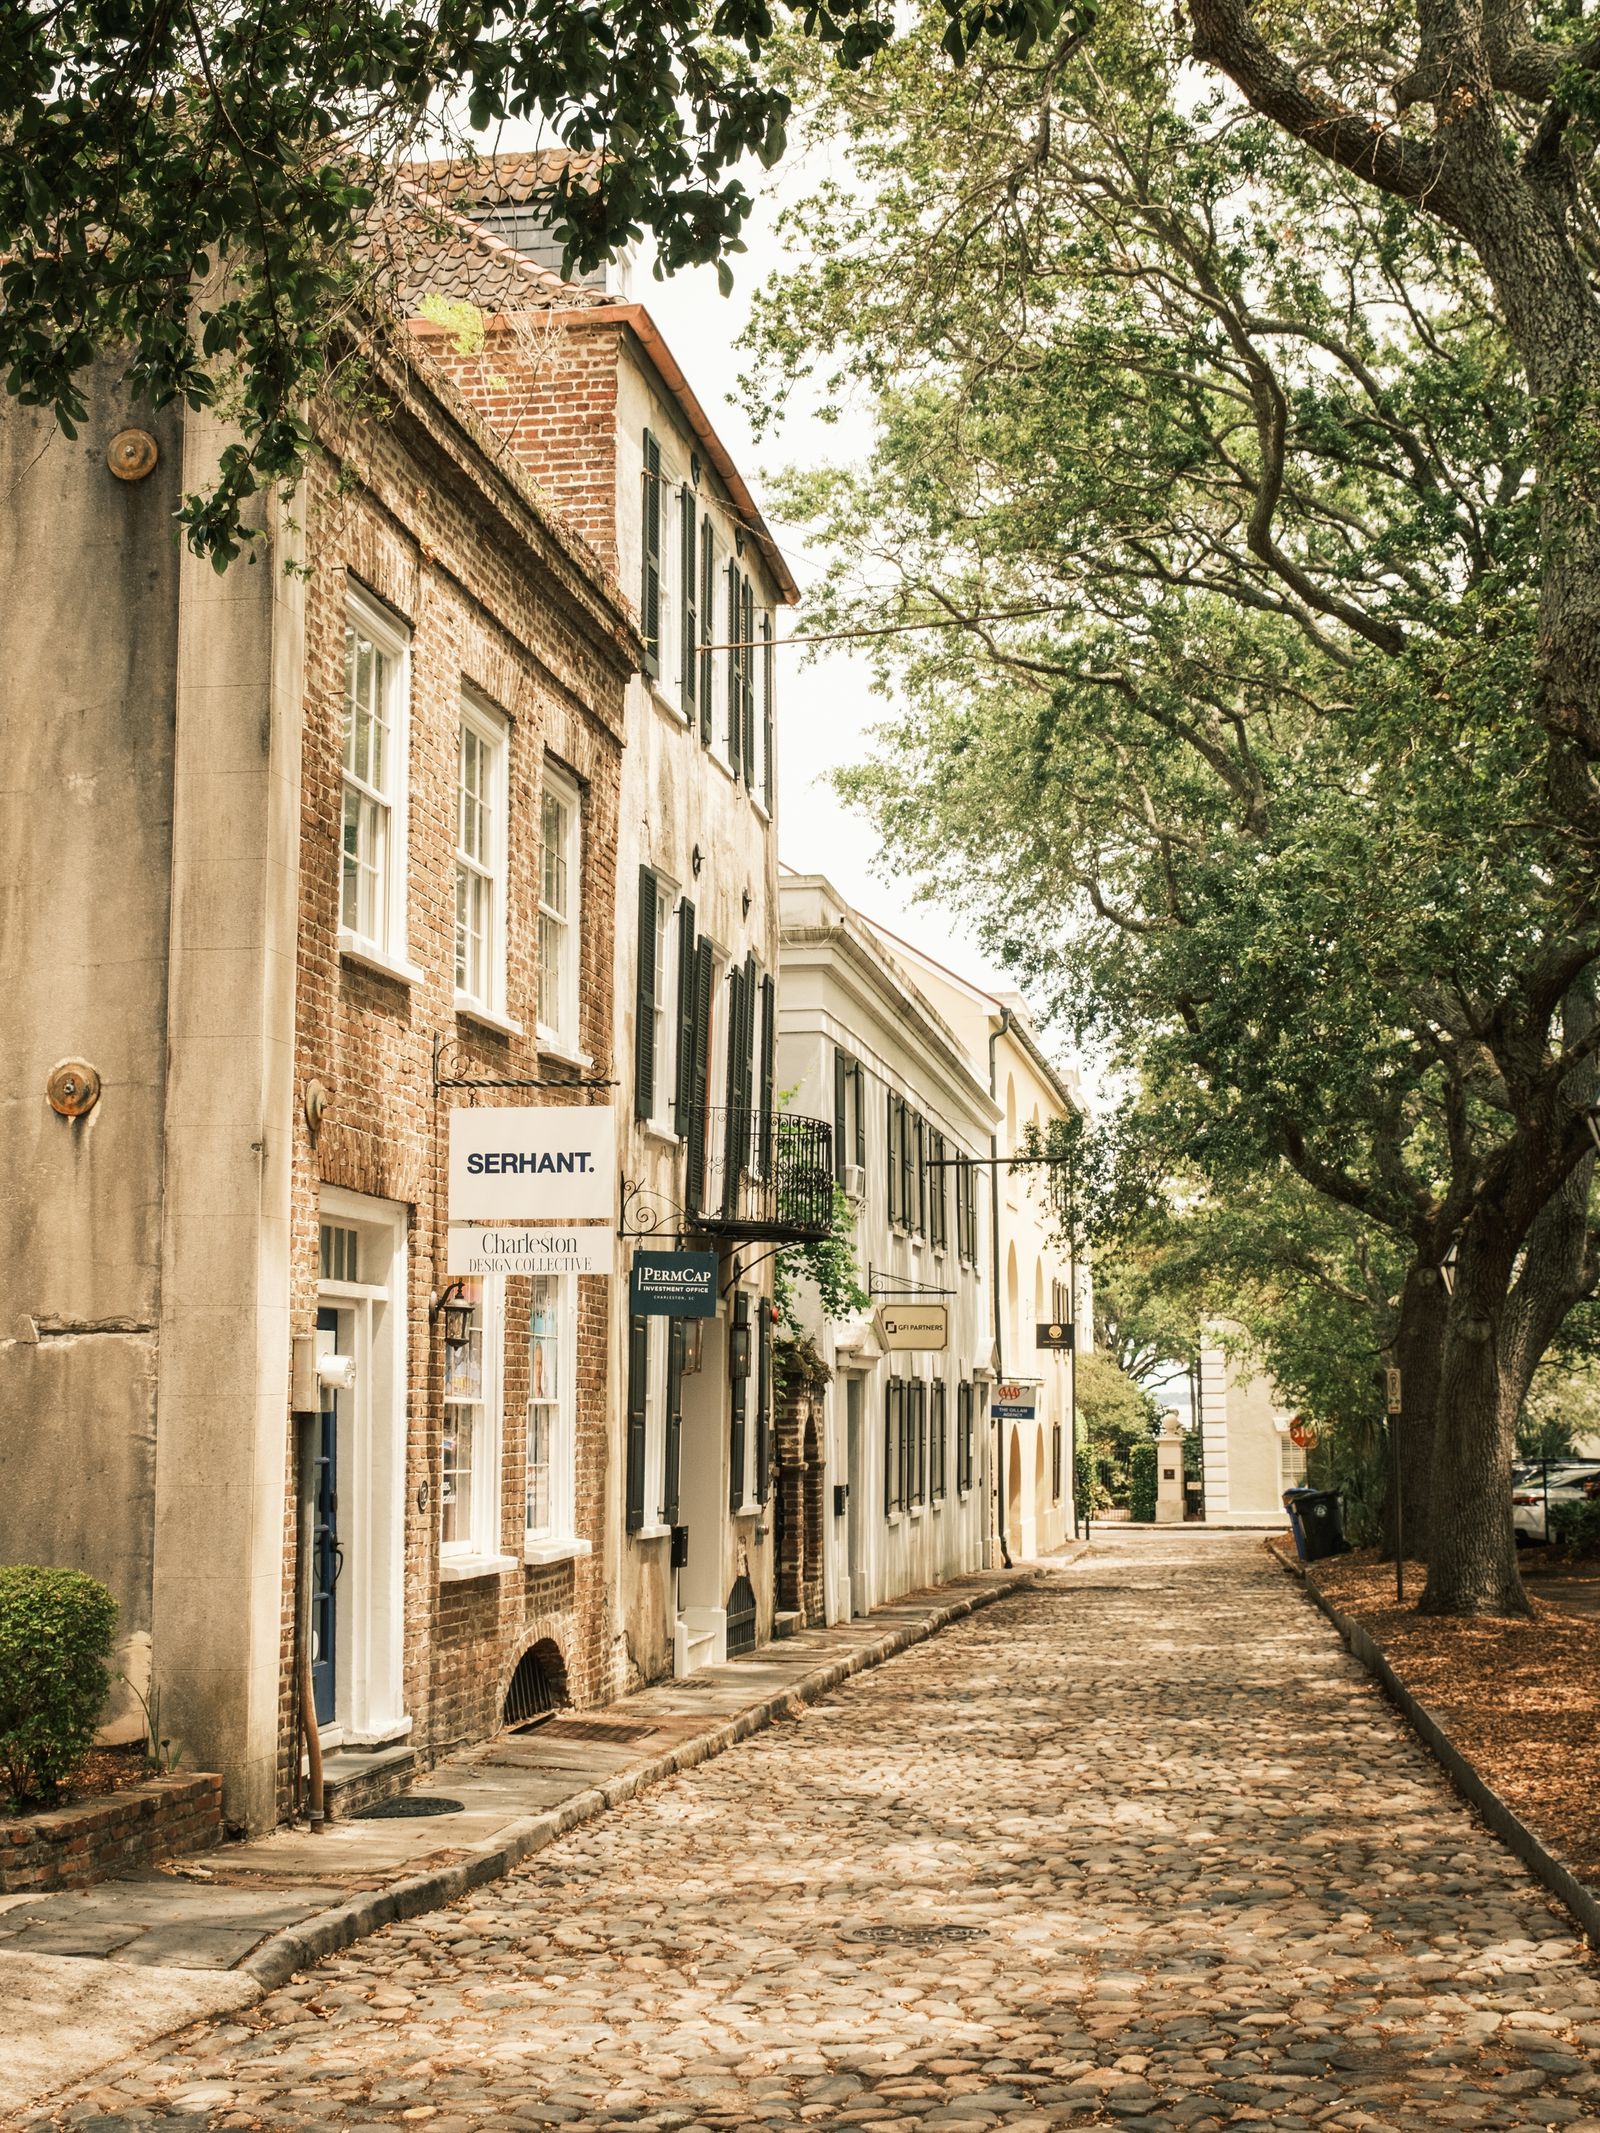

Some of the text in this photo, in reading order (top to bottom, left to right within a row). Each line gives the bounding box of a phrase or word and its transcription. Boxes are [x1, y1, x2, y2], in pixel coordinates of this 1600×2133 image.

[467, 1152, 594, 1174] SERHANT.
[482, 1231, 577, 1254] Charleston
[469, 1257, 592, 1272] DESIGN COLLECTIVE
[643, 1285, 684, 1293] INVESTMENT
[999, 1387, 1019, 1399] AAA
